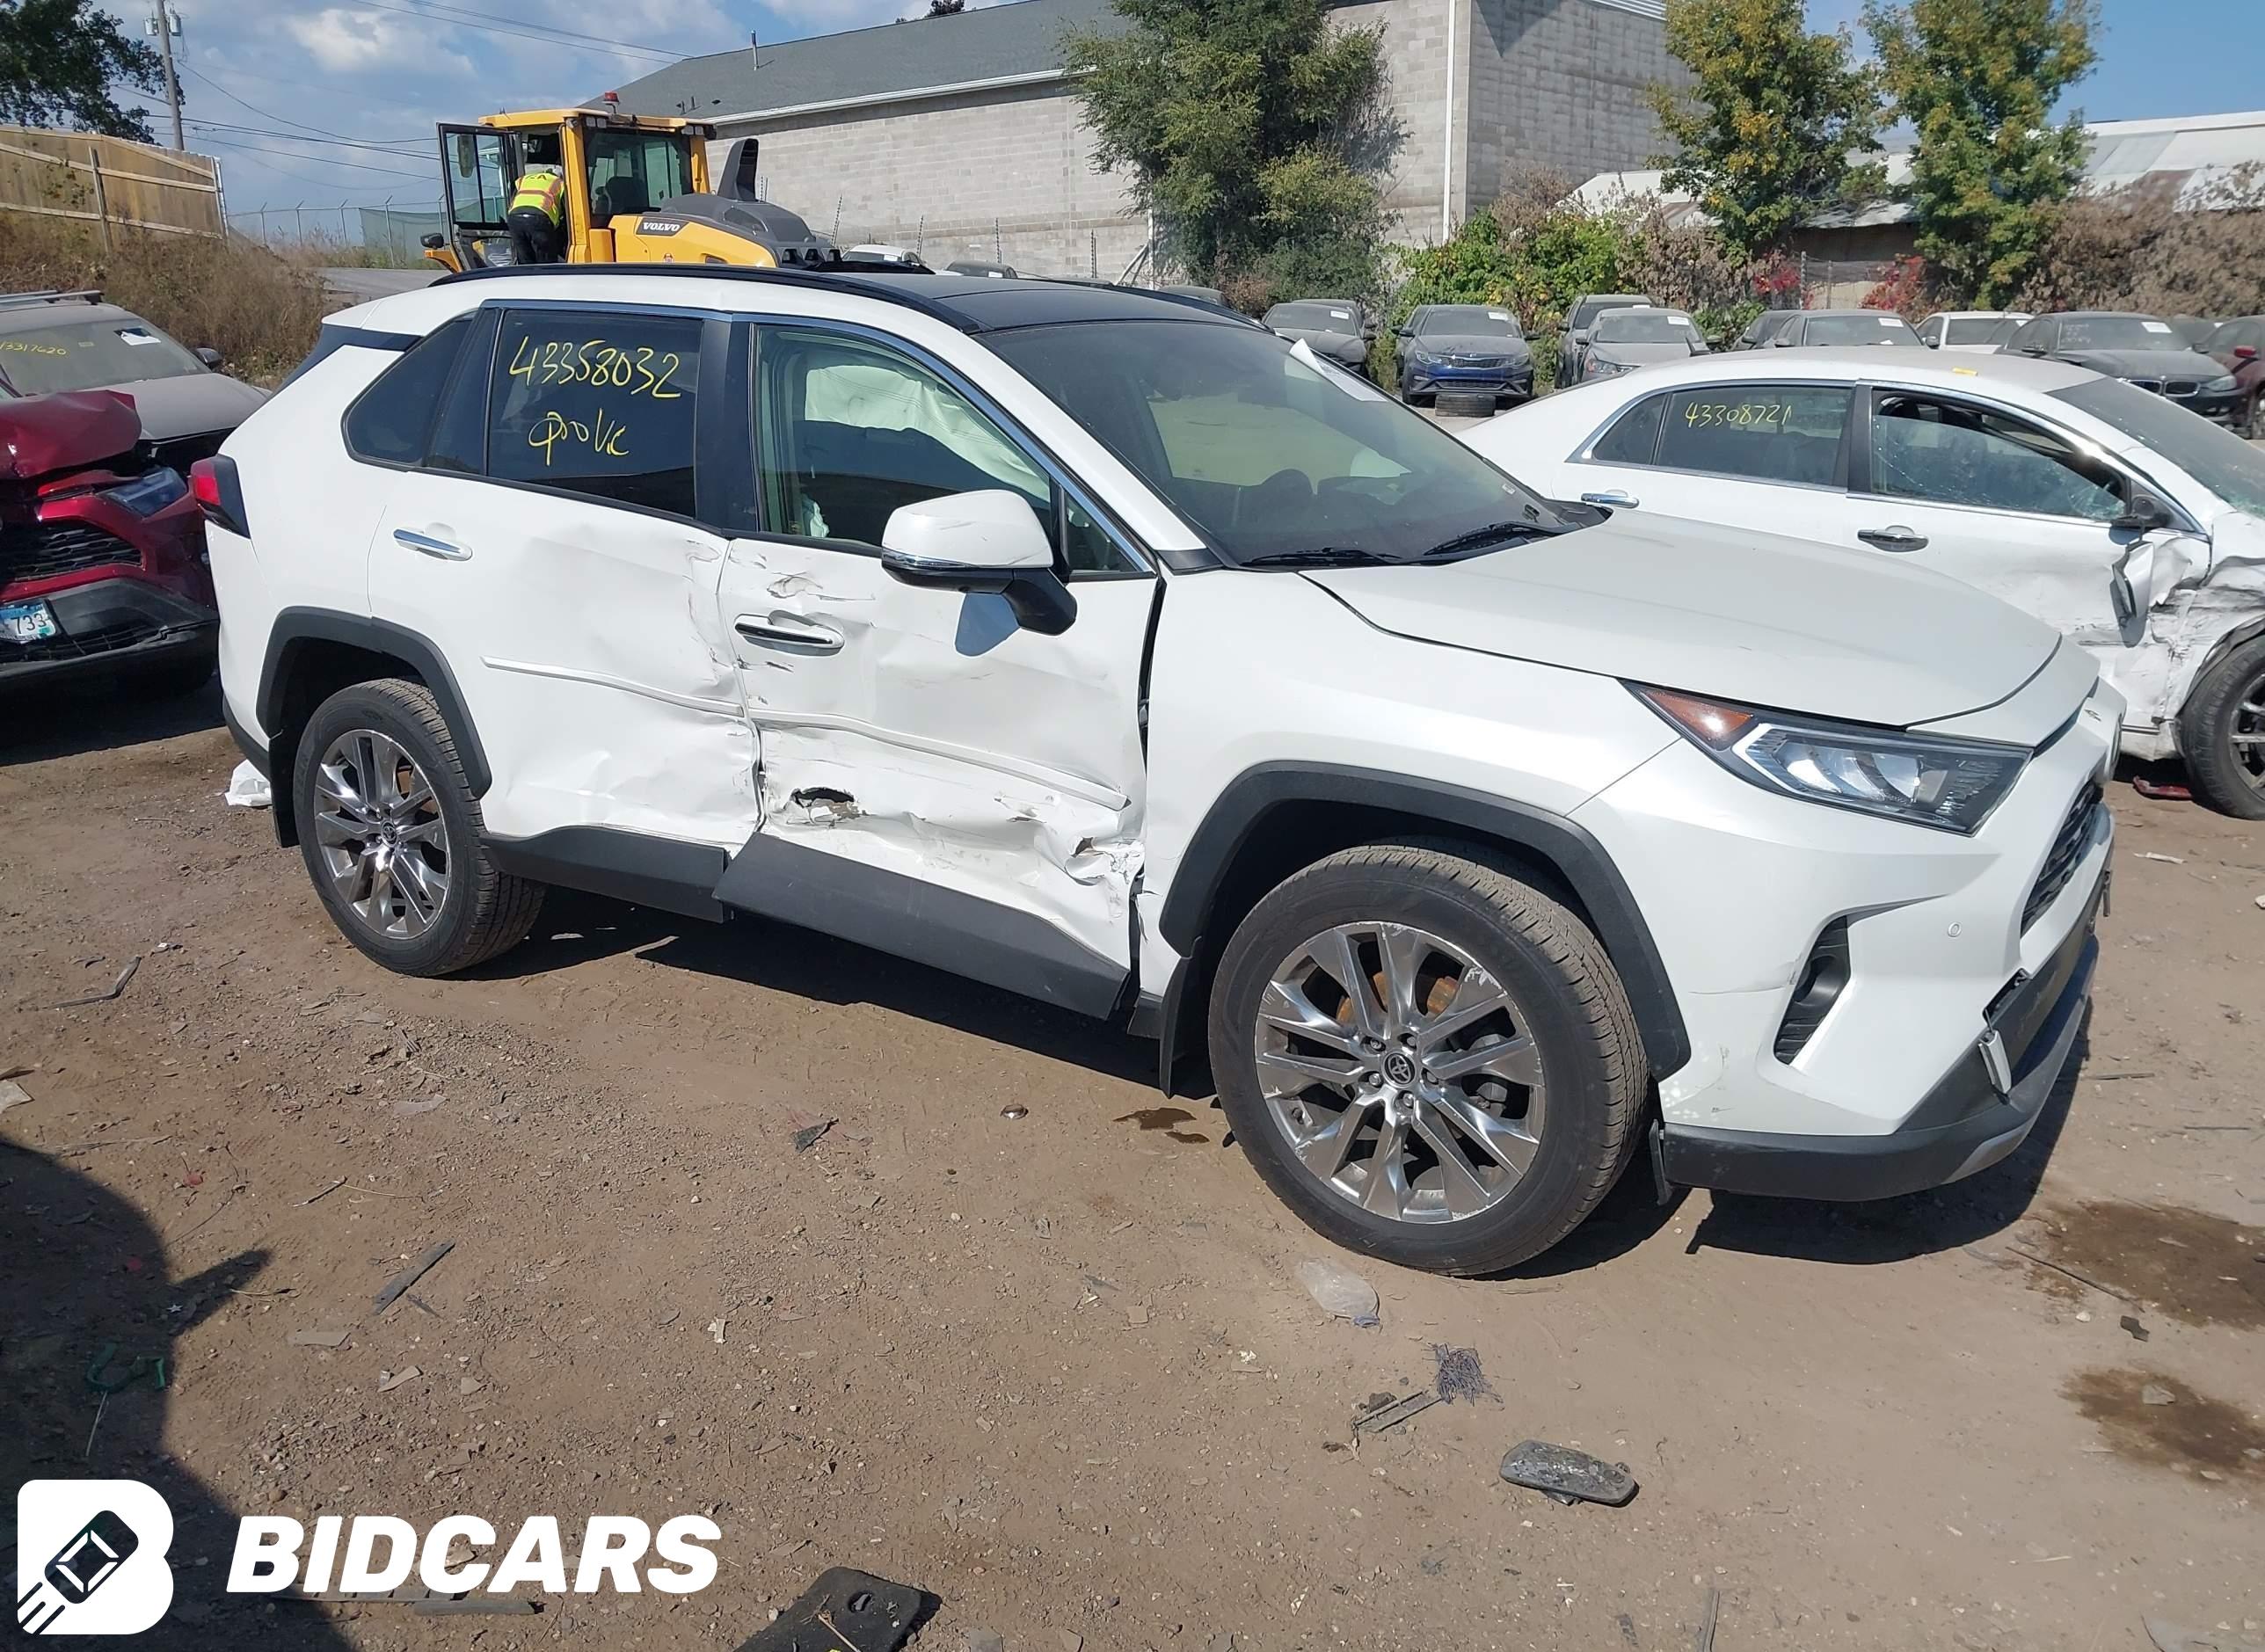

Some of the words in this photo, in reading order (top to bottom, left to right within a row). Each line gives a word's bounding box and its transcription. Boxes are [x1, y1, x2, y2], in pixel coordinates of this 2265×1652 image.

[643, 222, 681, 232] VOLVO
[508, 335, 681, 398] 43358032
[1684, 402, 1792, 428] 43308721
